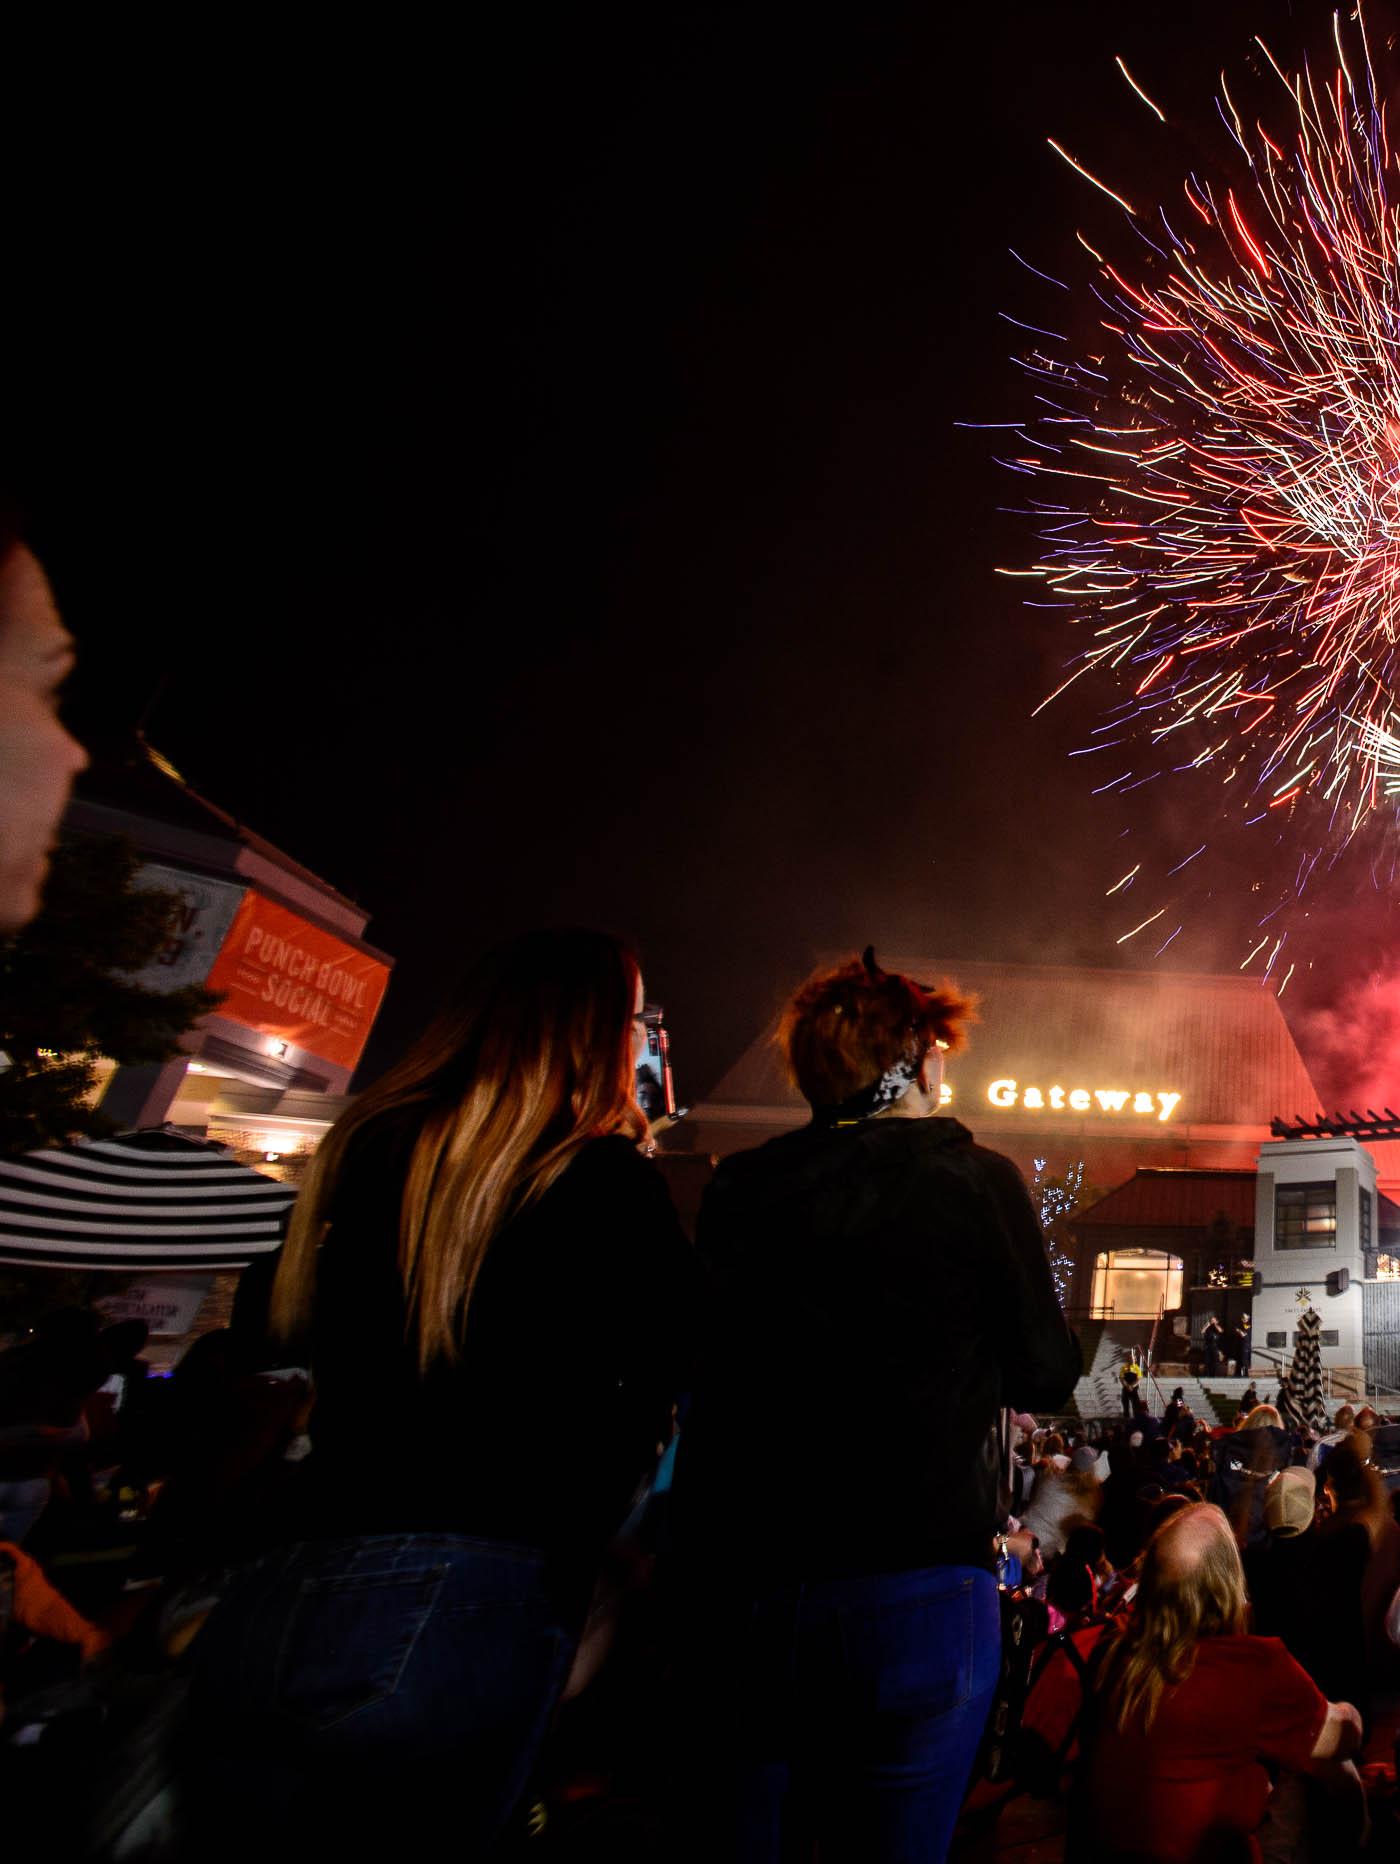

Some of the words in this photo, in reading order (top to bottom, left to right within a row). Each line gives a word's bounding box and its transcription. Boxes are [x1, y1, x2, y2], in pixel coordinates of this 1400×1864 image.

[244, 927, 319, 983] PUNCH
[316, 963, 368, 1009] BOWL
[261, 973, 331, 1027] SOCIAL
[987, 1079, 1182, 1121] Gateway
